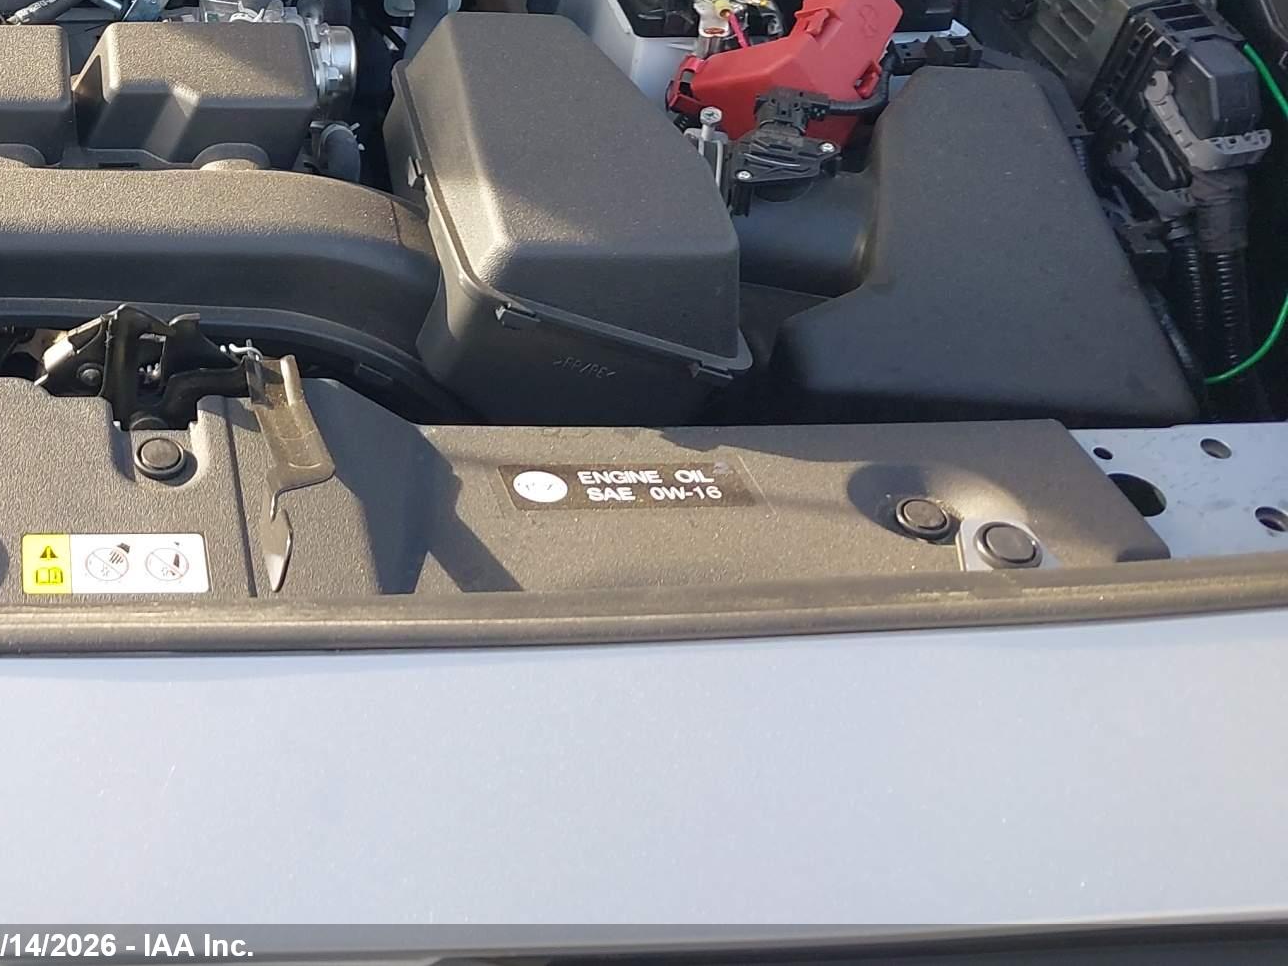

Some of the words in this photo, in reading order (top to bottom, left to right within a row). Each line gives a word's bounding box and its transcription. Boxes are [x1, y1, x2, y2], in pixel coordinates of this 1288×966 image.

[577, 470, 663, 484] ENGINE
[674, 469, 715, 483] OIL
[586, 486, 636, 501] SAE
[649, 485, 722, 501] 0W-16
